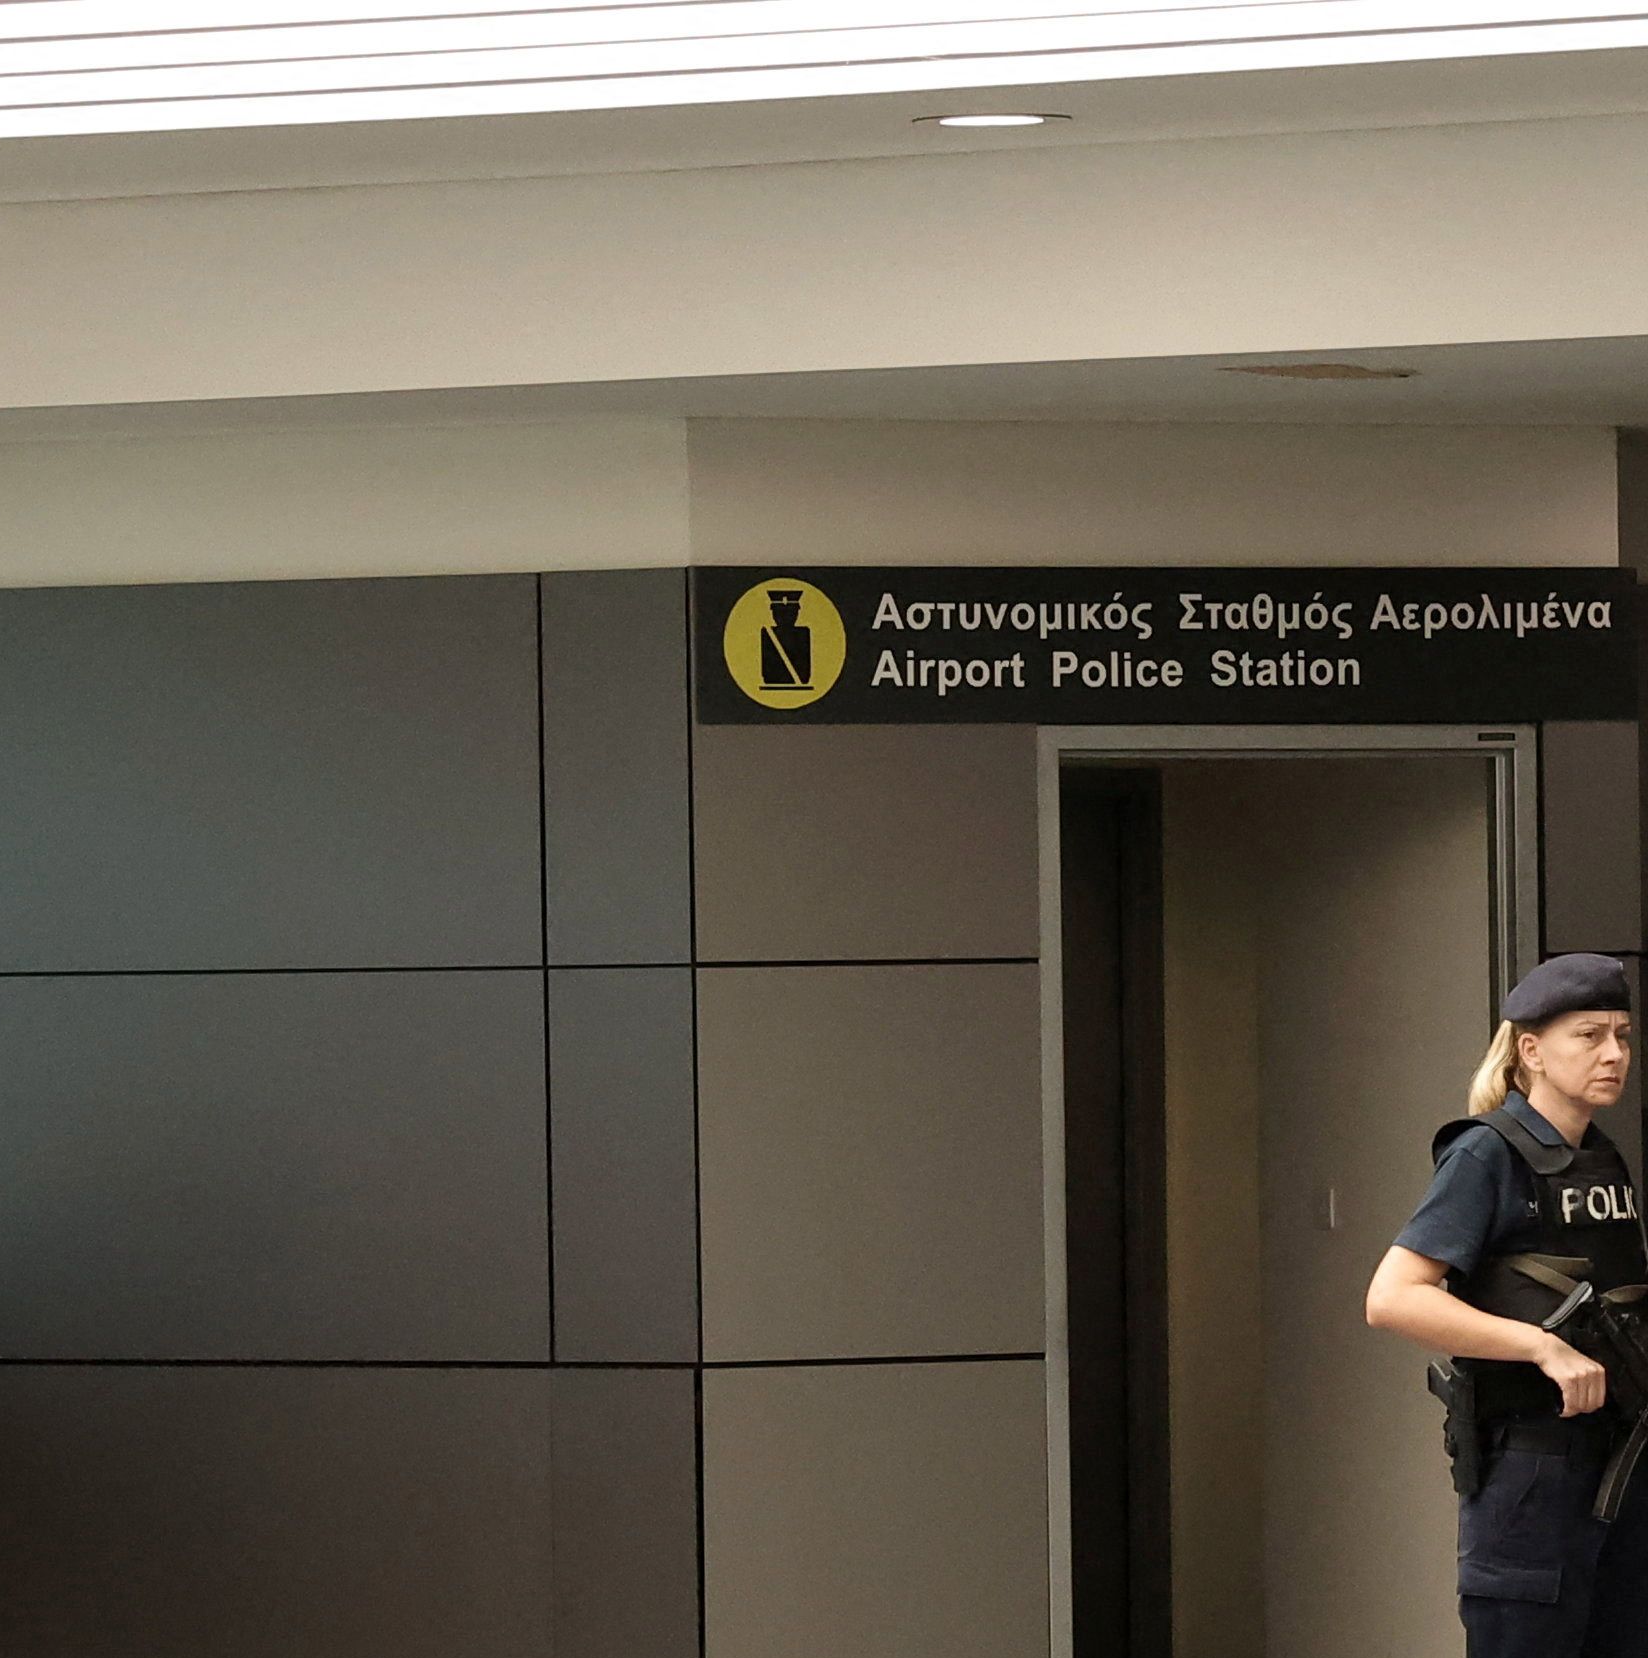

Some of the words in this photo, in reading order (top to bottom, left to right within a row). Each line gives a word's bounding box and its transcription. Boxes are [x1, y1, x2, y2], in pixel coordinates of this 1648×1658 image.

[871, 591, 1153, 640] Αστυνομικός
[1178, 591, 1353, 640] Σταθμός
[1369, 591, 1612, 639] Αερολιμένα
[870, 649, 1026, 697] Airport
[1052, 650, 1184, 688] Police
[1209, 648, 1361, 687] Station
